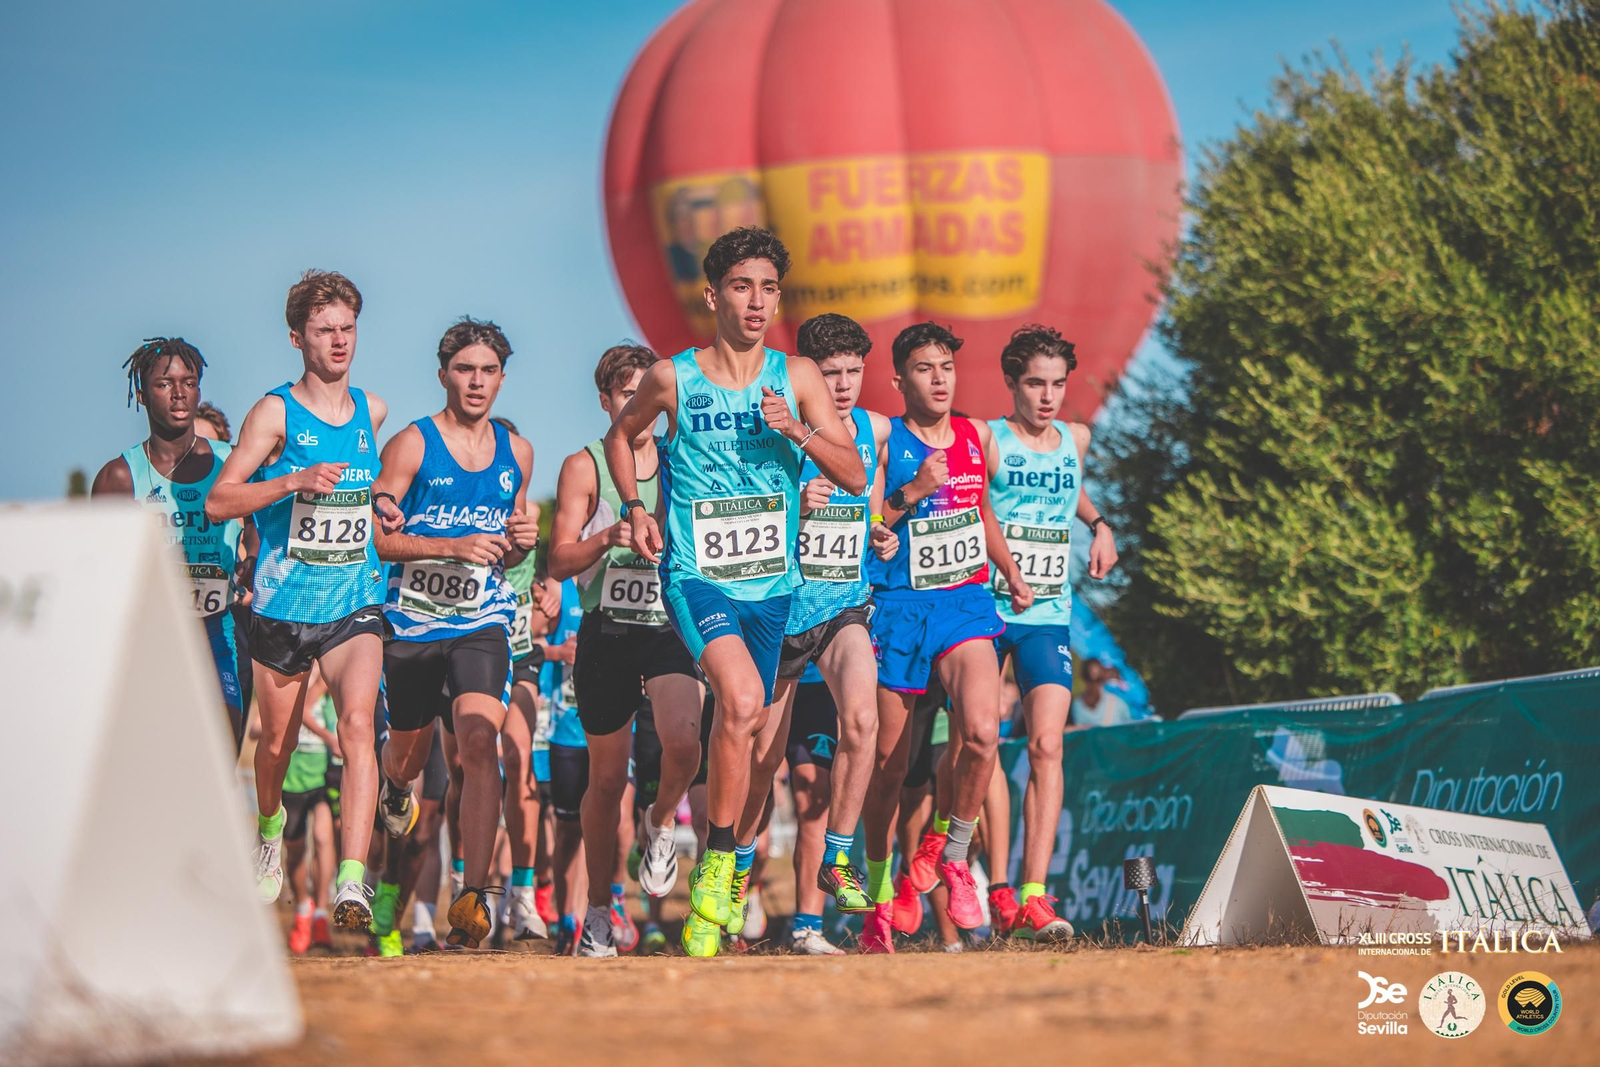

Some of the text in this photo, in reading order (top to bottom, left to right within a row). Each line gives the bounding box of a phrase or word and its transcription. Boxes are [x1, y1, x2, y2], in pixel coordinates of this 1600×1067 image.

[808, 159, 1026, 210] FUERZAS
[808, 211, 1026, 266] ARMADAS
[690, 403, 770, 436] nerj
[707, 437, 775, 453] ATLETISMO
[428, 477, 454, 487] vive
[1006, 466, 1076, 494] nerja
[719, 500, 762, 512] ITÁLICA
[297, 517, 367, 544] 8128
[933, 515, 967, 530] ITÁLICA
[1027, 527, 1061, 540] ITÁLICA
[704, 524, 780, 559] 8123
[800, 532, 859, 559] 8141
[918, 535, 981, 569] 8103
[409, 569, 481, 601] 8080
[698, 612, 728, 627] nerja
[1411, 758, 1564, 815] Diputación
[1081, 784, 1193, 842] Diputación
[1428, 828, 1551, 860] CROSS INTERNACIONAL DE
[1443, 854, 1577, 928] ITÁLICA
